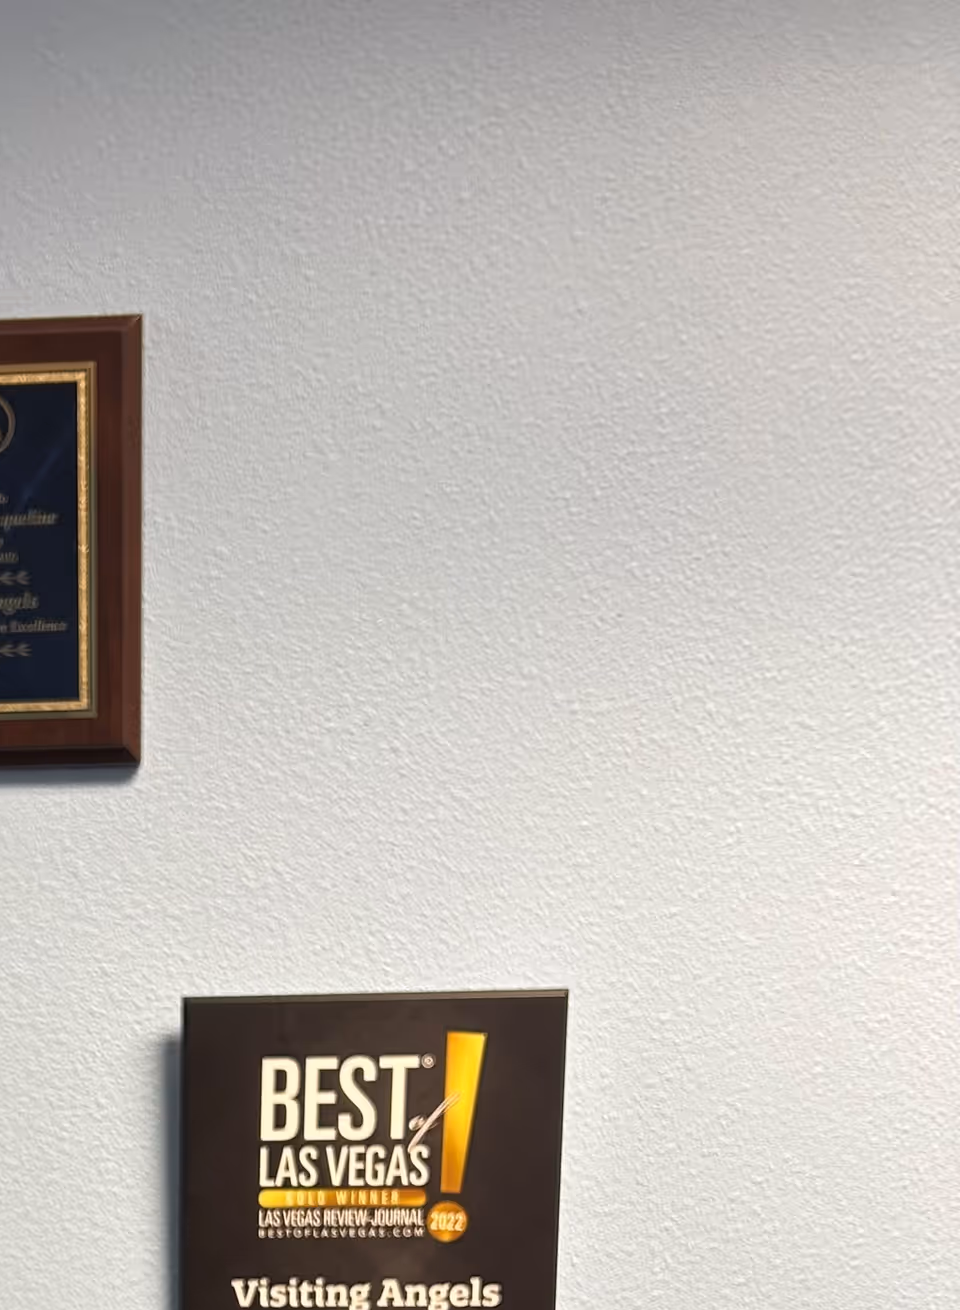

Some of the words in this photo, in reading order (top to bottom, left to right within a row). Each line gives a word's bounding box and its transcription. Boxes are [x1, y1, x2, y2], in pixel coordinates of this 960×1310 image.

[260, 1054, 420, 1141] BEST
[259, 1145, 319, 1187] LAS
[326, 1145, 431, 1187] VEGAS
[336, 1190, 401, 1205] WINNER
[259, 1209, 281, 1227] LAS
[283, 1209, 321, 1227] VEGAS
[323, 1209, 425, 1227] REVIEW-JOURNAL
[430, 1212, 465, 1231] 2022
